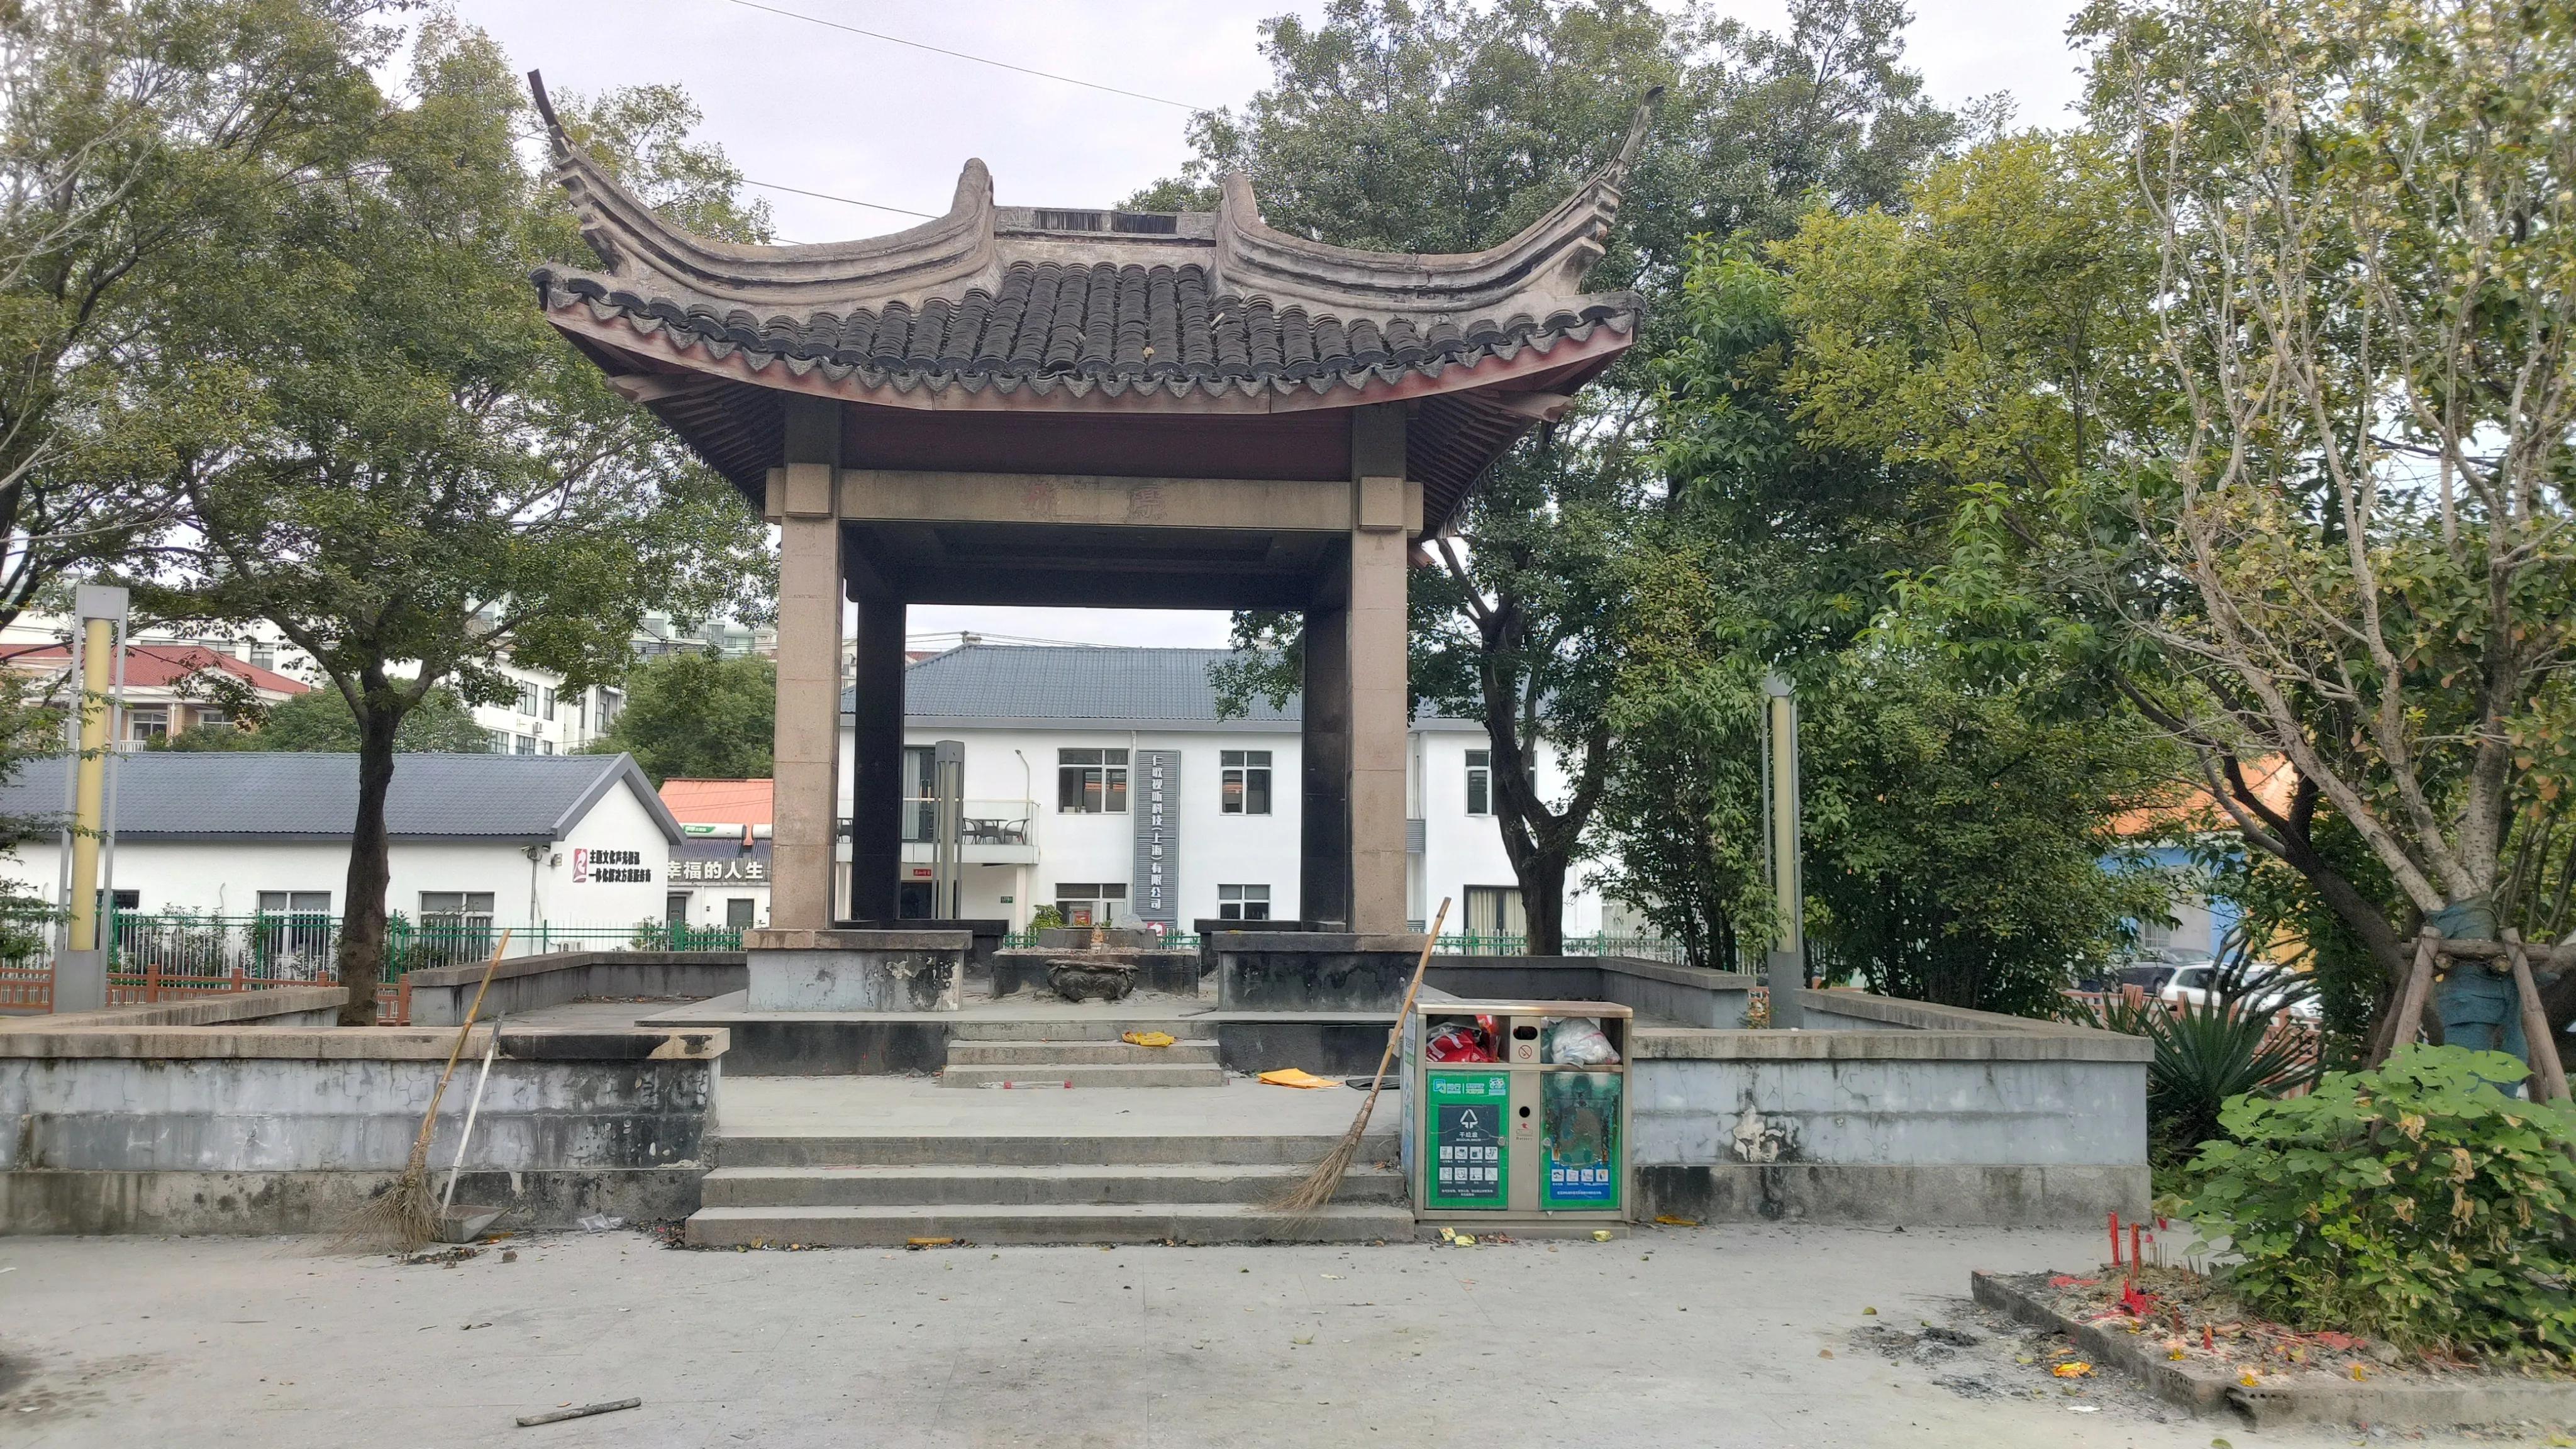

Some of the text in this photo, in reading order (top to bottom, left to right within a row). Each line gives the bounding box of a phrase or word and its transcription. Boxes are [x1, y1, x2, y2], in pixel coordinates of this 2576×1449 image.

[667, 860, 763, 880] 幸福的人生
